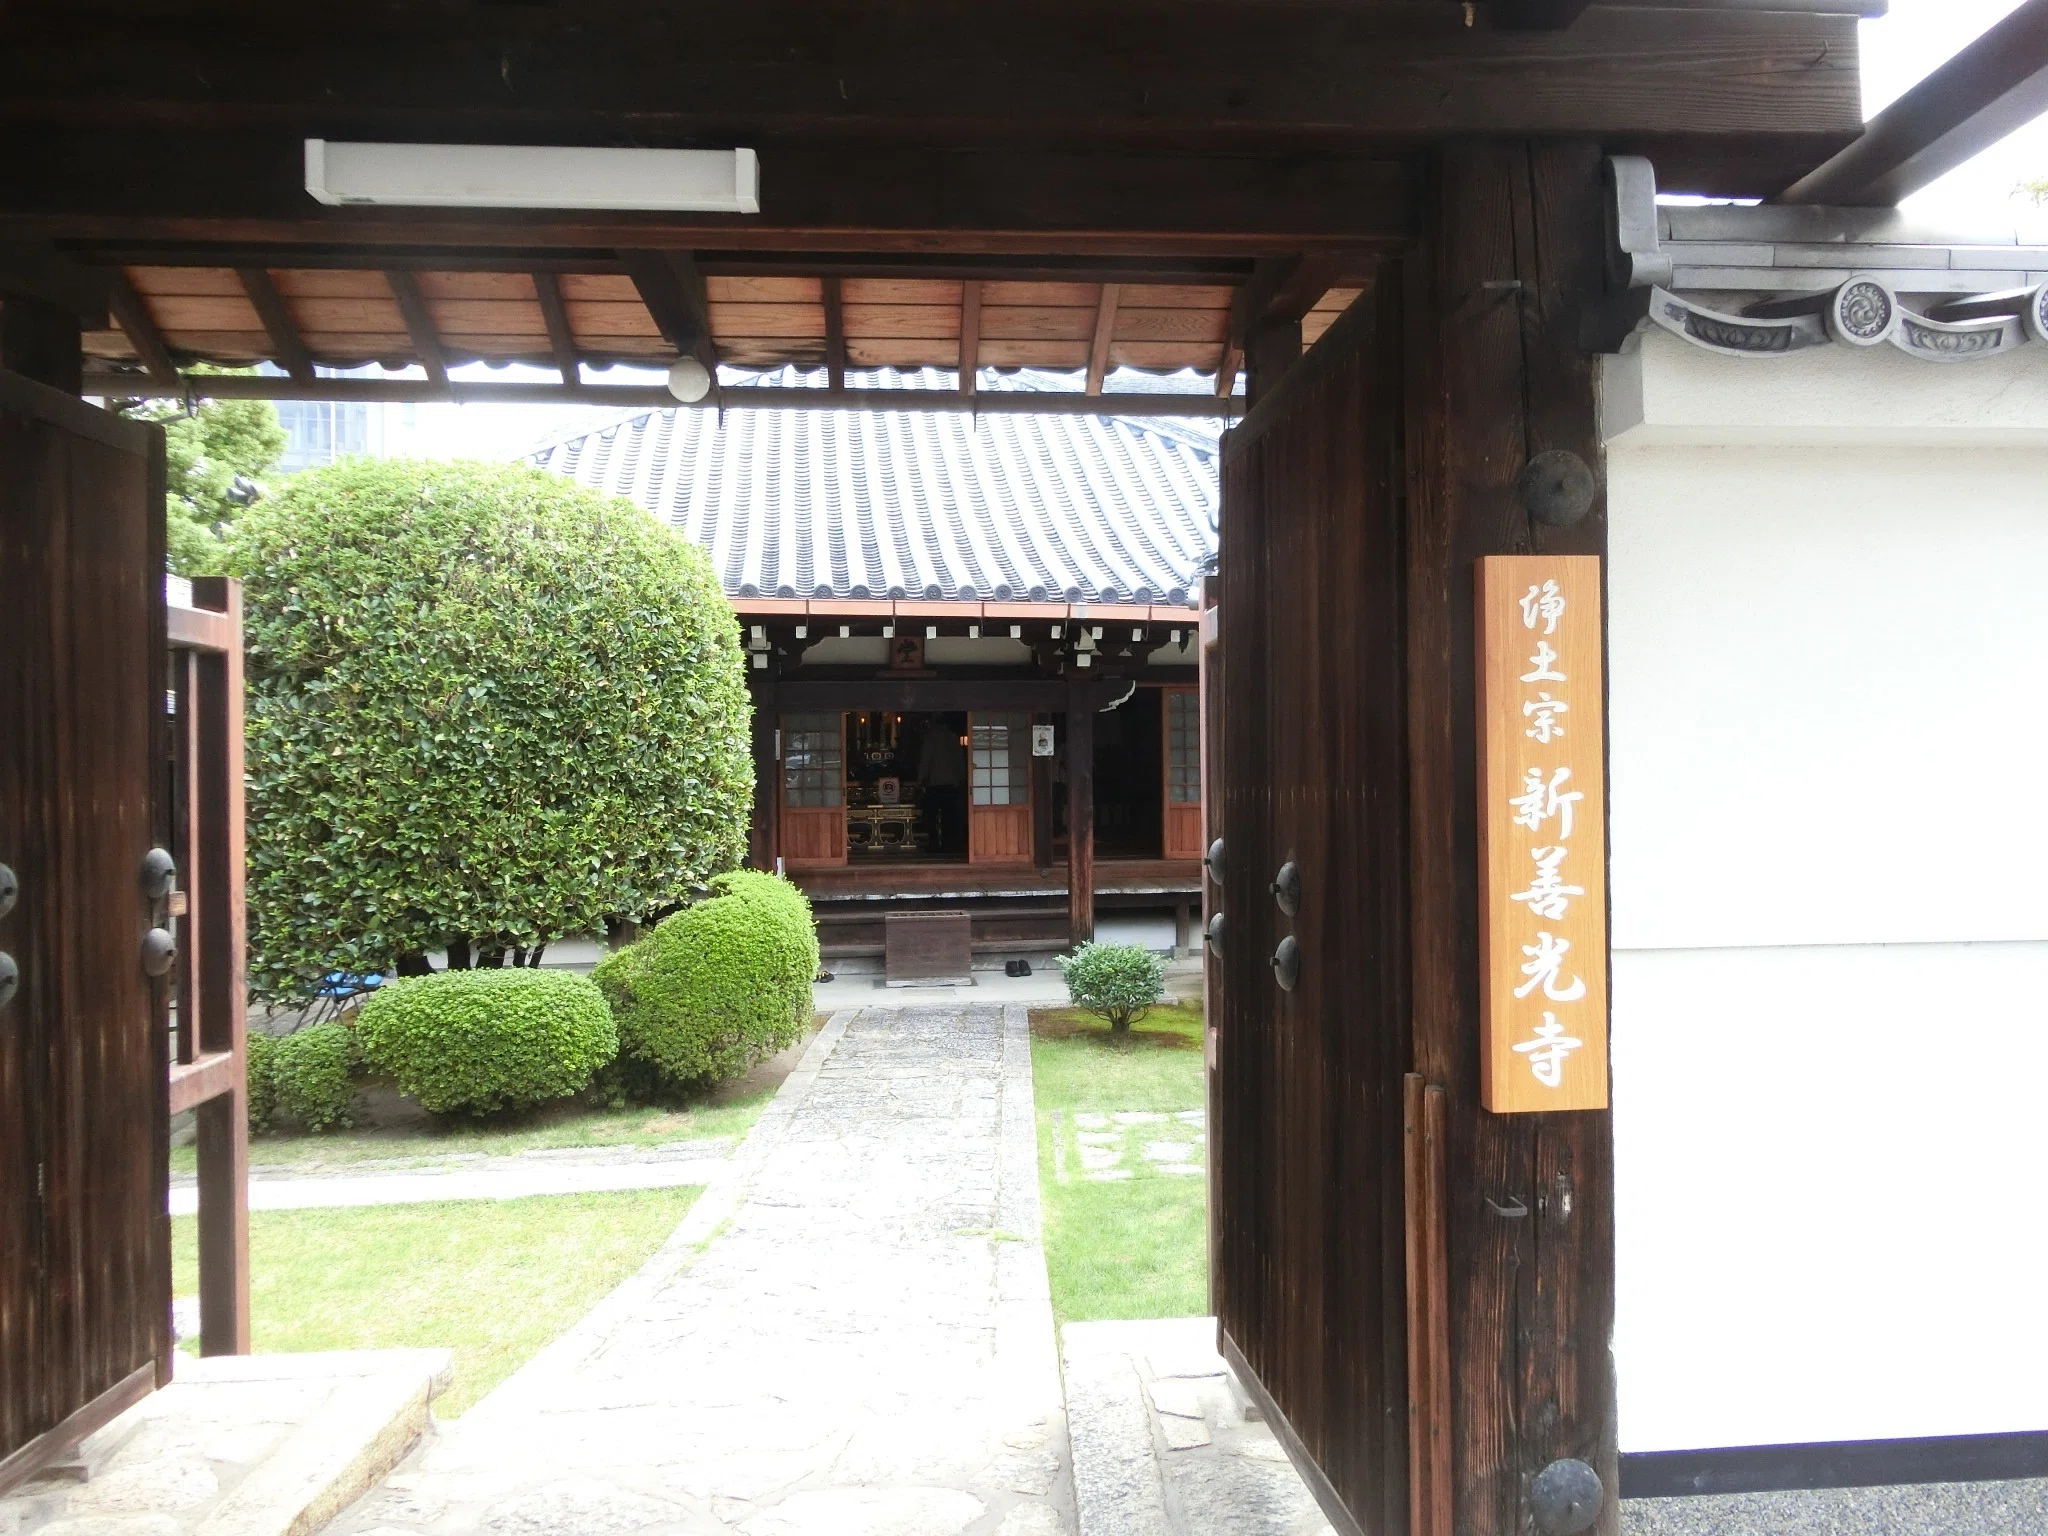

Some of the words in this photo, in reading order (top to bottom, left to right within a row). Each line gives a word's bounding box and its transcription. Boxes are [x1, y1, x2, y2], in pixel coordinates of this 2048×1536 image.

[1518, 578, 1570, 745] 浄土宗
[1508, 766, 1588, 1089] 新善光寺
